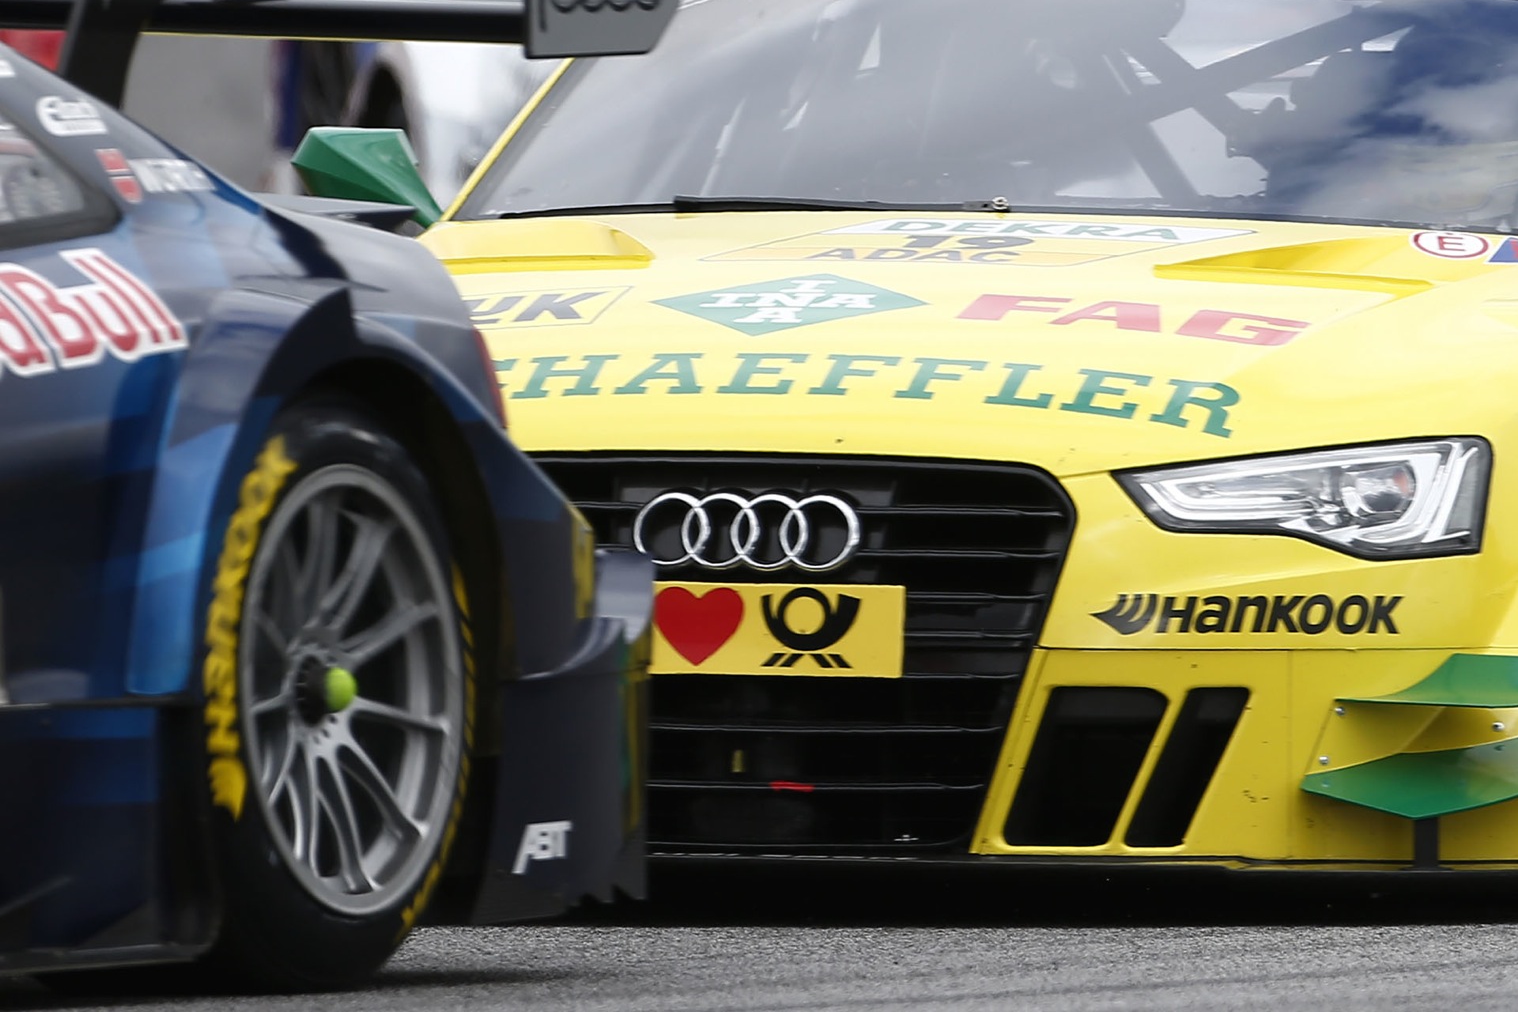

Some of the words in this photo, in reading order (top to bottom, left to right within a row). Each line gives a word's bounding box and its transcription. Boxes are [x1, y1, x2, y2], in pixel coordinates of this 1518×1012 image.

[880, 219, 1182, 241] DEKRA
[901, 235, 1034, 250] 19
[804, 248, 1021, 263] ADAC
[462, 291, 613, 324] UK
[956, 293, 1311, 346] FAG
[511, 820, 574, 875] ABT
